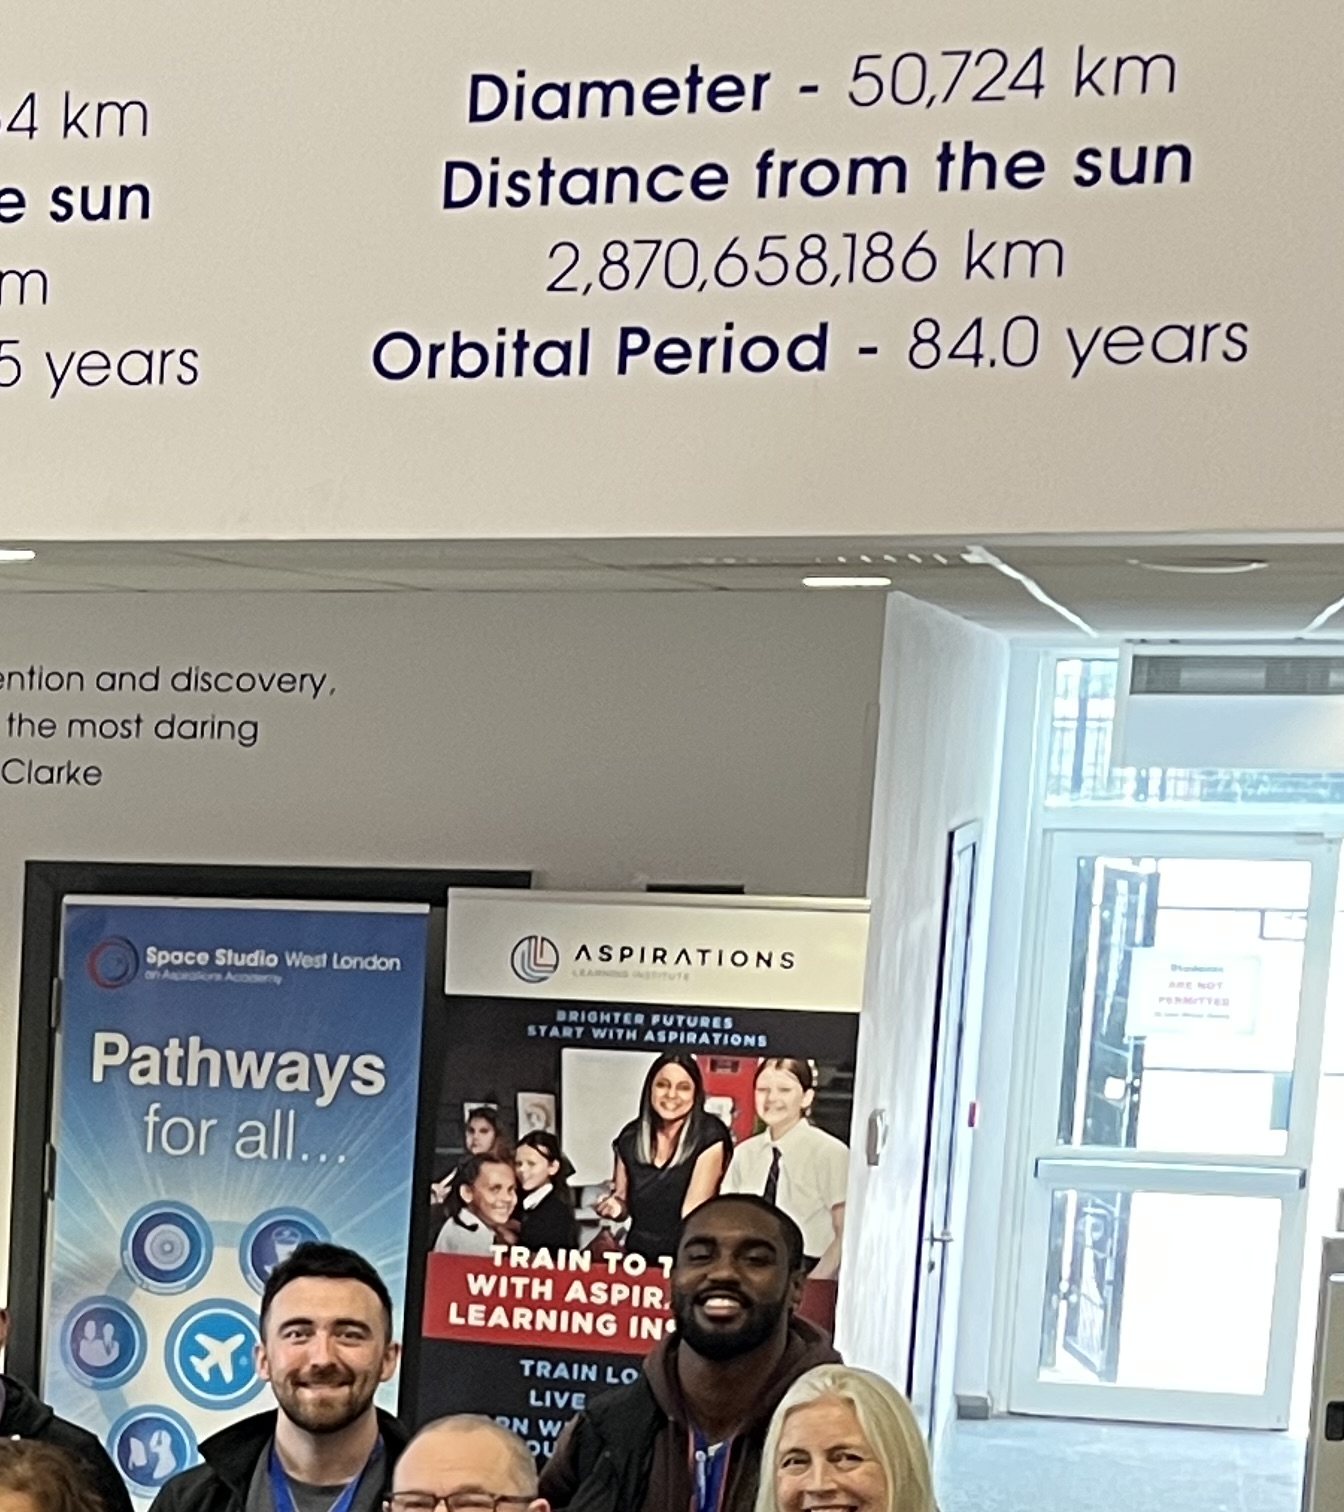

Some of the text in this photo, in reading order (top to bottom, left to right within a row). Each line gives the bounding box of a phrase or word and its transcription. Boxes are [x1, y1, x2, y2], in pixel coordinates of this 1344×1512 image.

[468, 63, 772, 124] Diameter
[848, 47, 1045, 109] 50,724
[1074, 44, 1176, 98] km
[63, 90, 148, 139] km
[443, 140, 1192, 210] Distance from the sun
[49, 183, 150, 223] sun
[546, 228, 1064, 296] 2,870,658,186 km
[372, 327, 590, 381] Orbital
[617, 321, 829, 376] Period
[908, 315, 1039, 370] 84.0
[1066, 322, 1248, 379] years
[45, 348, 199, 399] years
[95, 665, 160, 692] and
[170, 666, 336, 700] discovery,
[7, 712, 57, 739] the
[67, 713, 143, 740] most
[154, 713, 259, 748] daring
[1, 757, 103, 786] Clarke
[146, 946, 401, 971] Space Studio West London
[575, 944, 795, 970] ASPIRATIONS
[527, 1025, 769, 1047] START WITH ASPIRATIONS
[556, 1010, 733, 1029] BRIGHTER FUTURES
[92, 1032, 386, 1108] Pathways
[143, 1102, 346, 1163] for all...
[489, 1244, 592, 1272] TRAIN
[603, 1251, 646, 1277] TO
[466, 1273, 553, 1301] WITH
[448, 1302, 617, 1336] LEARNING
[519, 1359, 597, 1381] TRAIN
[529, 1389, 586, 1410] LIVE
